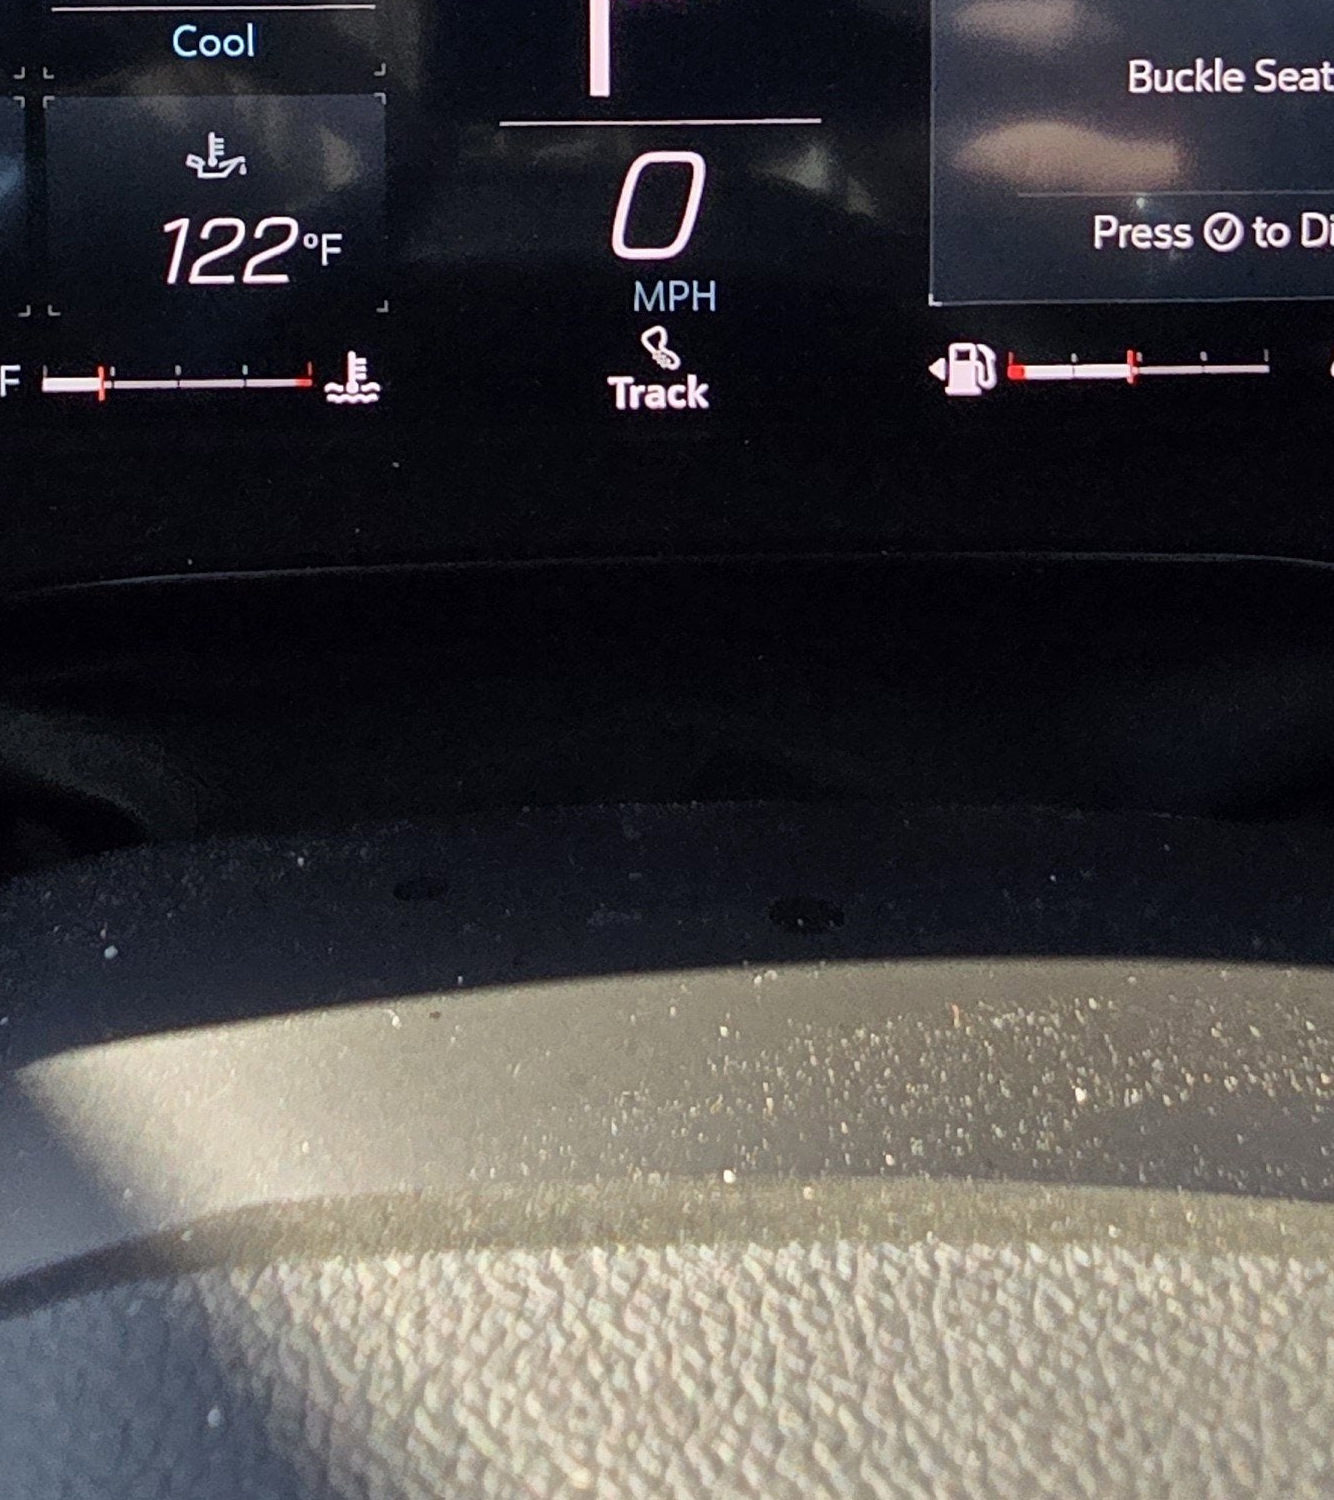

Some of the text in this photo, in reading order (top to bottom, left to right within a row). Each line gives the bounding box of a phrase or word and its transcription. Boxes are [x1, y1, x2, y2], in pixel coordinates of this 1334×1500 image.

[172, 22, 255, 58] Cool
[1128, 57, 1246, 94] Buckle
[611, 150, 706, 260] 0
[1094, 214, 1194, 249] Press
[1251, 216, 1291, 248] to
[633, 280, 716, 312] MPH
[606, 376, 710, 410] Track
